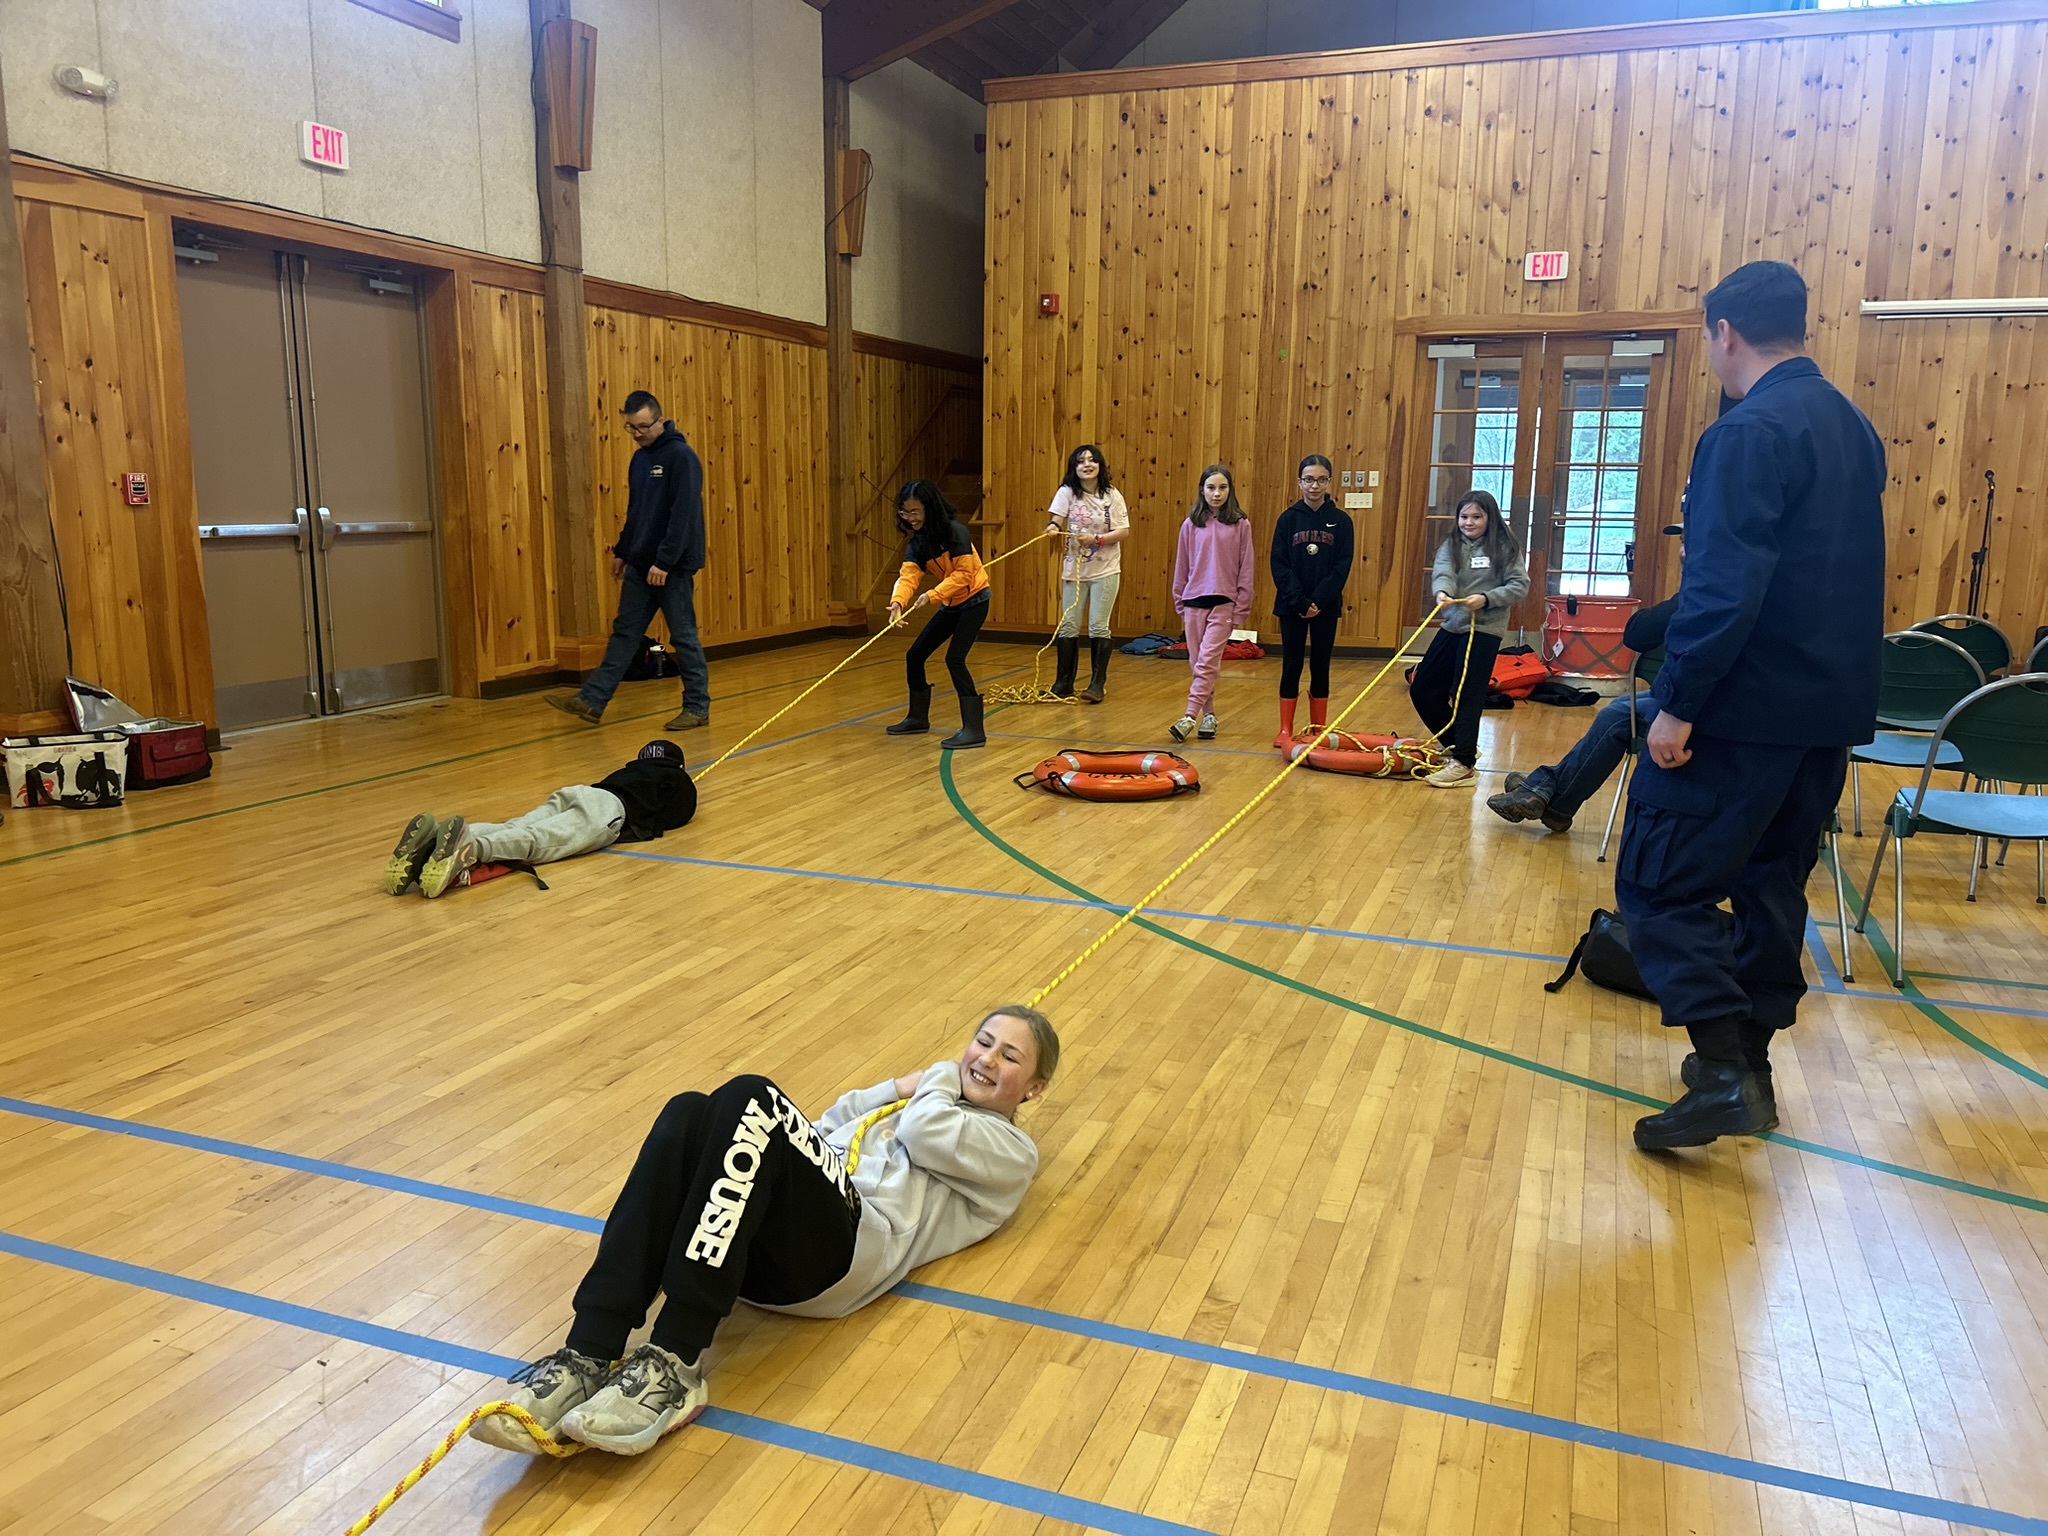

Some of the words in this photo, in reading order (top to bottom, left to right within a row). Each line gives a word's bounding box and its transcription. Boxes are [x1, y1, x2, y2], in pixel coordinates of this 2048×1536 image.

[312, 125, 343, 165] EXIT
[1531, 253, 1563, 278] EXIT
[130, 474, 146, 482] FIRE
[685, 1097, 779, 1269] MOUSE
